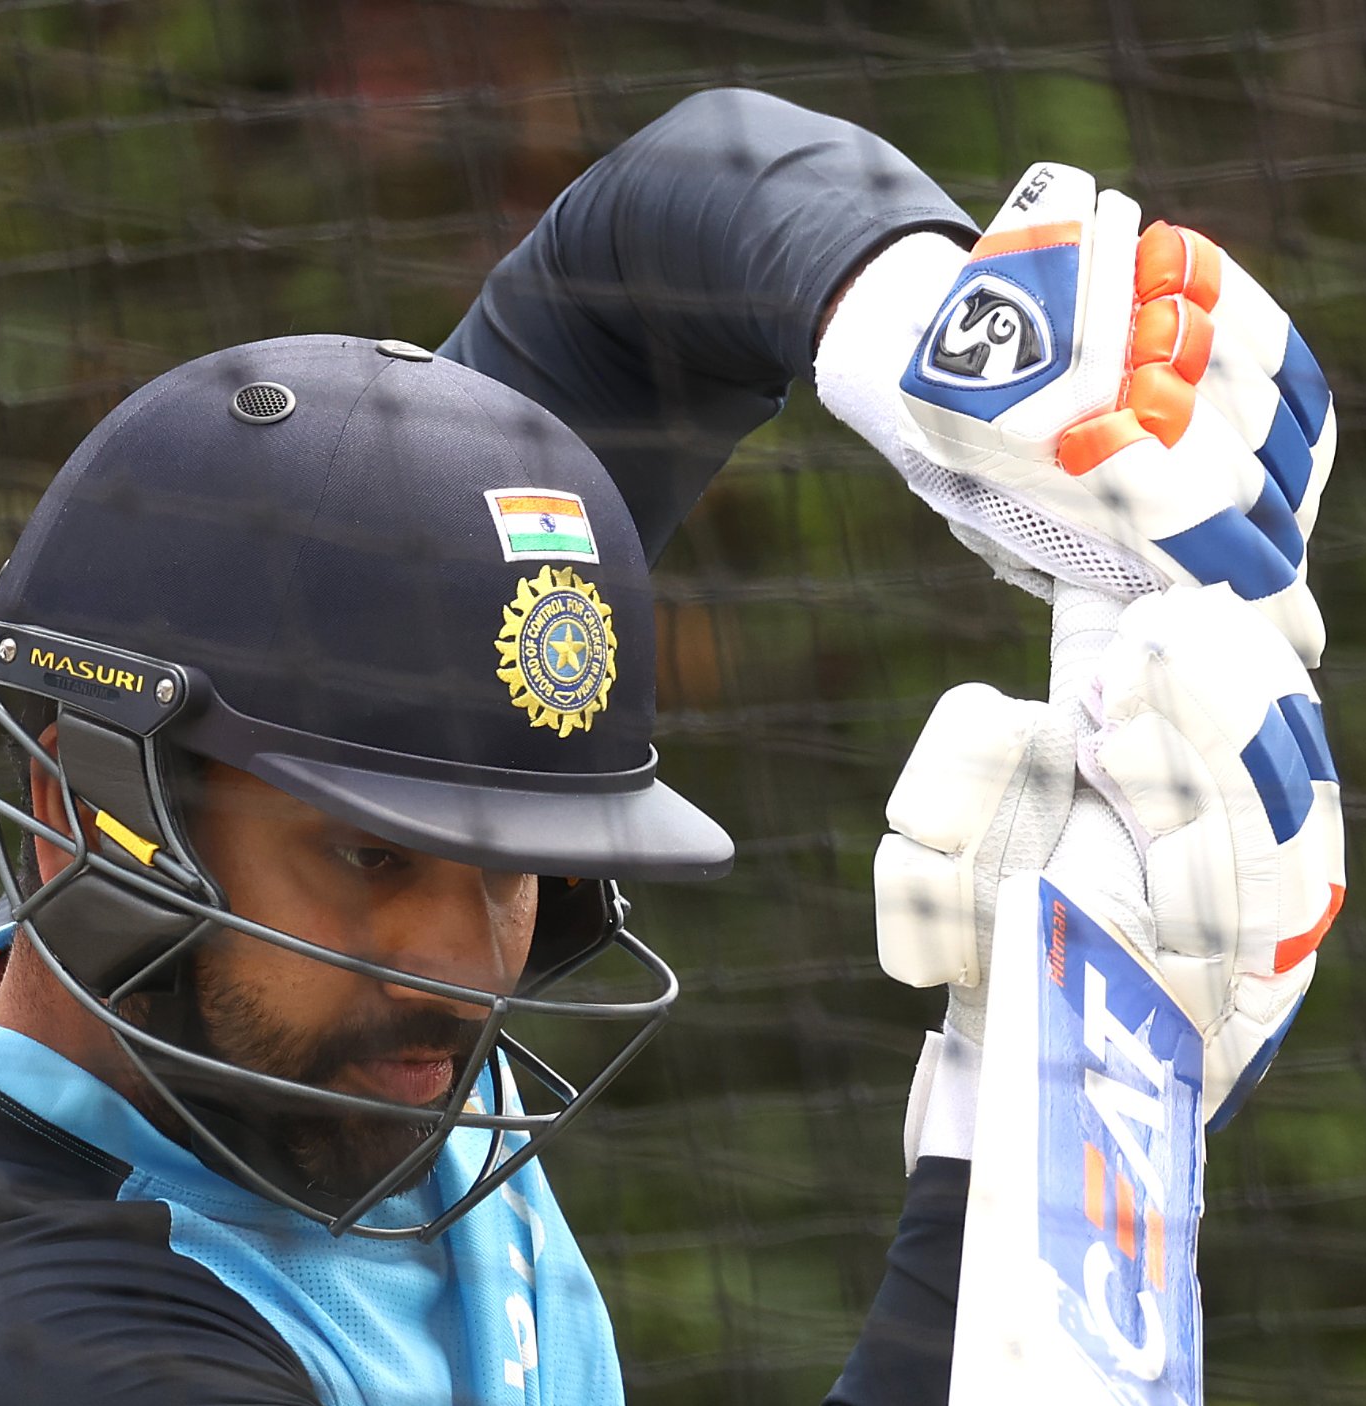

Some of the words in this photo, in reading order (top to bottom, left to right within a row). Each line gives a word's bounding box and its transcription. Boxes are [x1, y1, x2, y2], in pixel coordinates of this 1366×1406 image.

[1012, 167, 1055, 212] TEST
[527, 599, 565, 638] CONTROL
[566, 598, 585, 616] FOR
[525, 639, 538, 657] OF
[583, 611, 603, 661] CRICKET
[30, 648, 144, 693] MASURI
[528, 658, 555, 697] BOARD
[575, 675, 596, 700] INDIA
[591, 661, 601, 675] IN
[1048, 900, 1066, 987] Hitman
[1083, 962, 1167, 1380] CEAT
